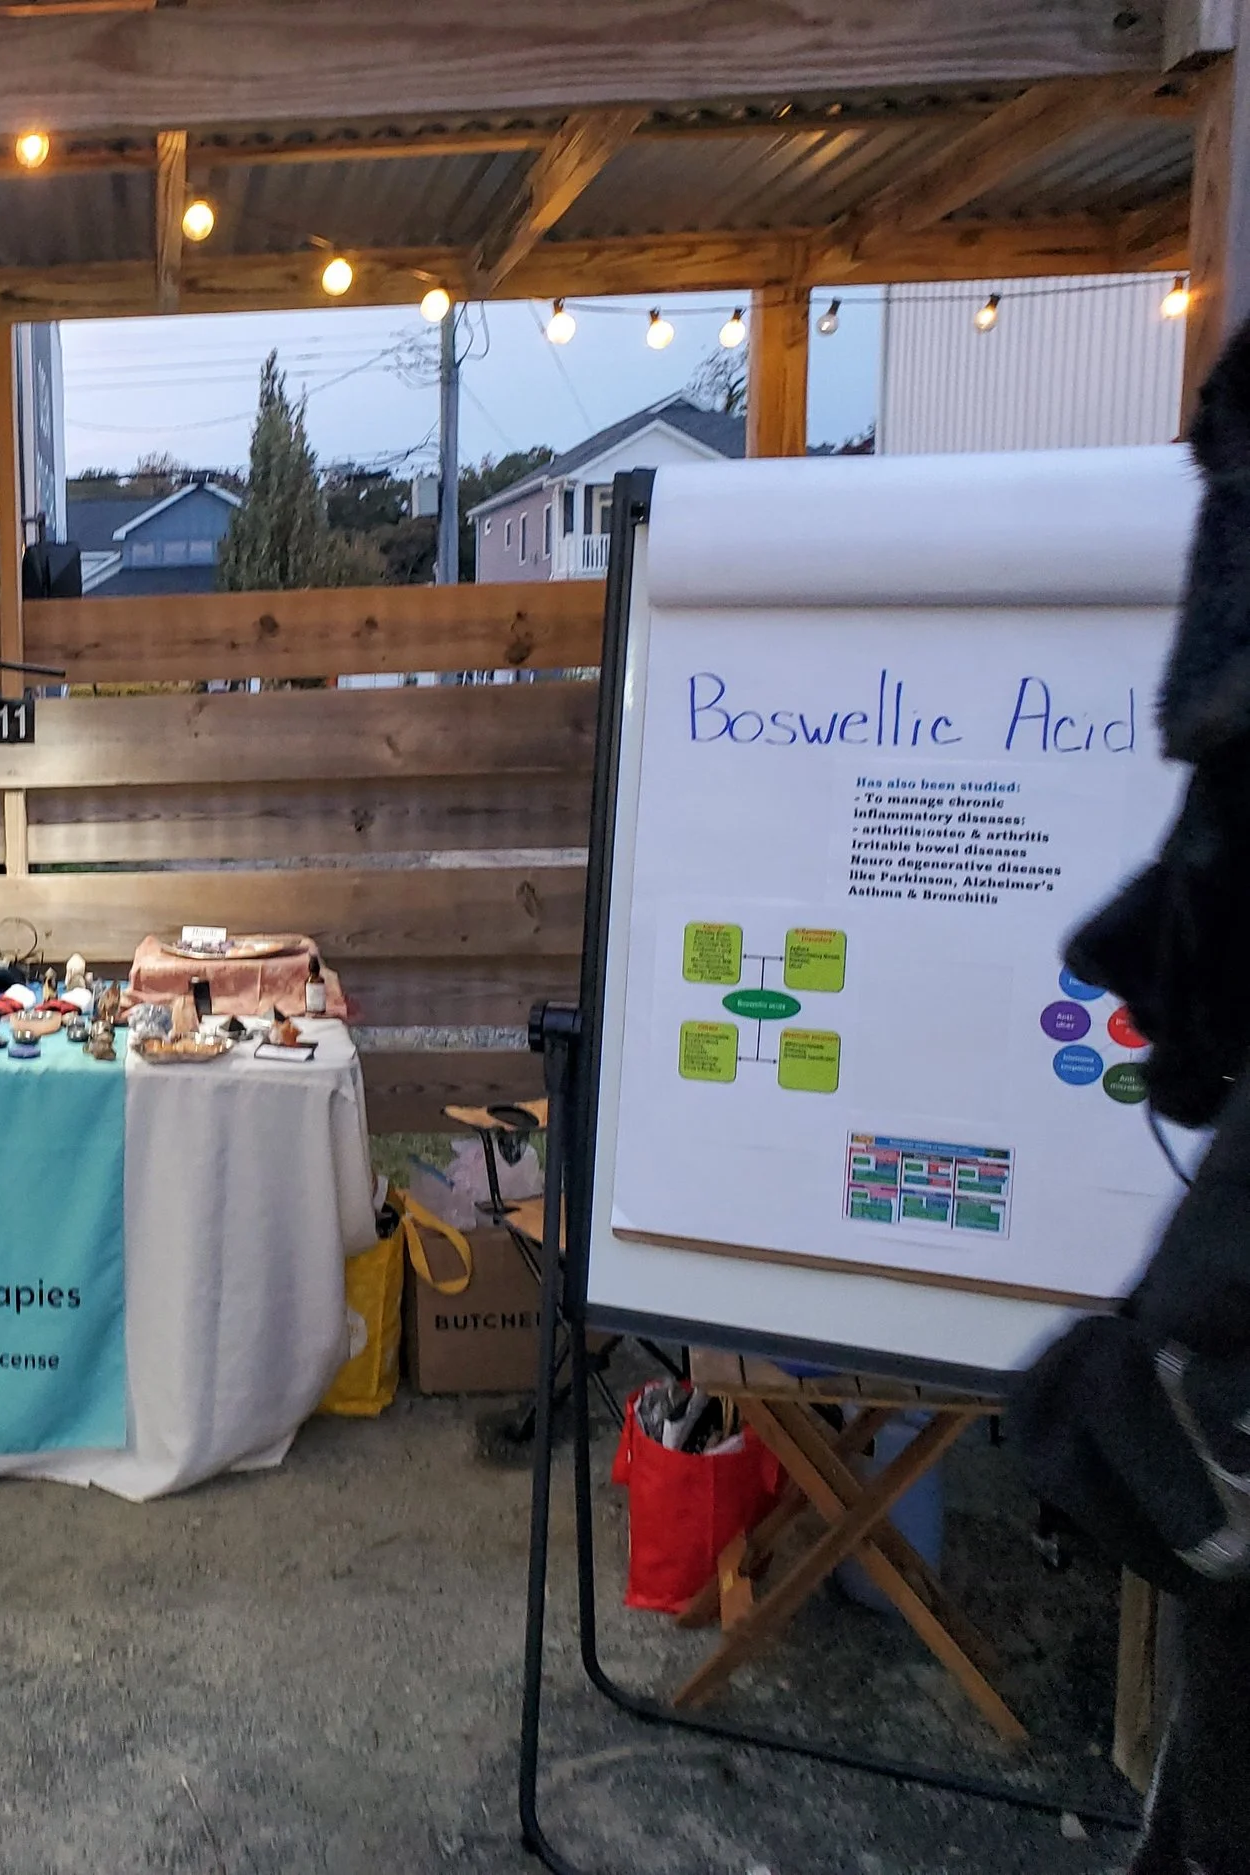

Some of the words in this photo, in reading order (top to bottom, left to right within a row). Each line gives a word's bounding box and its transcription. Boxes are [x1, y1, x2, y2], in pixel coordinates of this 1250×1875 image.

[688, 669, 963, 747] Boswellic
[1005, 676, 1136, 753] Acid
[856, 777, 882, 788] Has
[888, 778, 915, 789] also
[921, 779, 954, 791] been
[865, 792, 882, 804] To
[888, 795, 944, 809] manage
[949, 795, 1004, 809] chronic
[854, 807, 953, 824] inflammatory
[970, 828, 981, 839] &
[986, 830, 1050, 843] arthritis
[852, 839, 911, 851] Irritable
[916, 842, 959, 854] bowel
[964, 845, 1027, 858] diseases
[850, 855, 893, 867] Neuro
[897, 857, 992, 872] degenerative
[997, 863, 1061, 876] diseases
[849, 870, 875, 881] like
[880, 871, 958, 888] Parkinson,
[848, 885, 902, 898] Asthma
[907, 888, 917, 899] &
[923, 889, 998, 905] Bronchitis
[435, 1311, 541, 1331] BUTCHE
